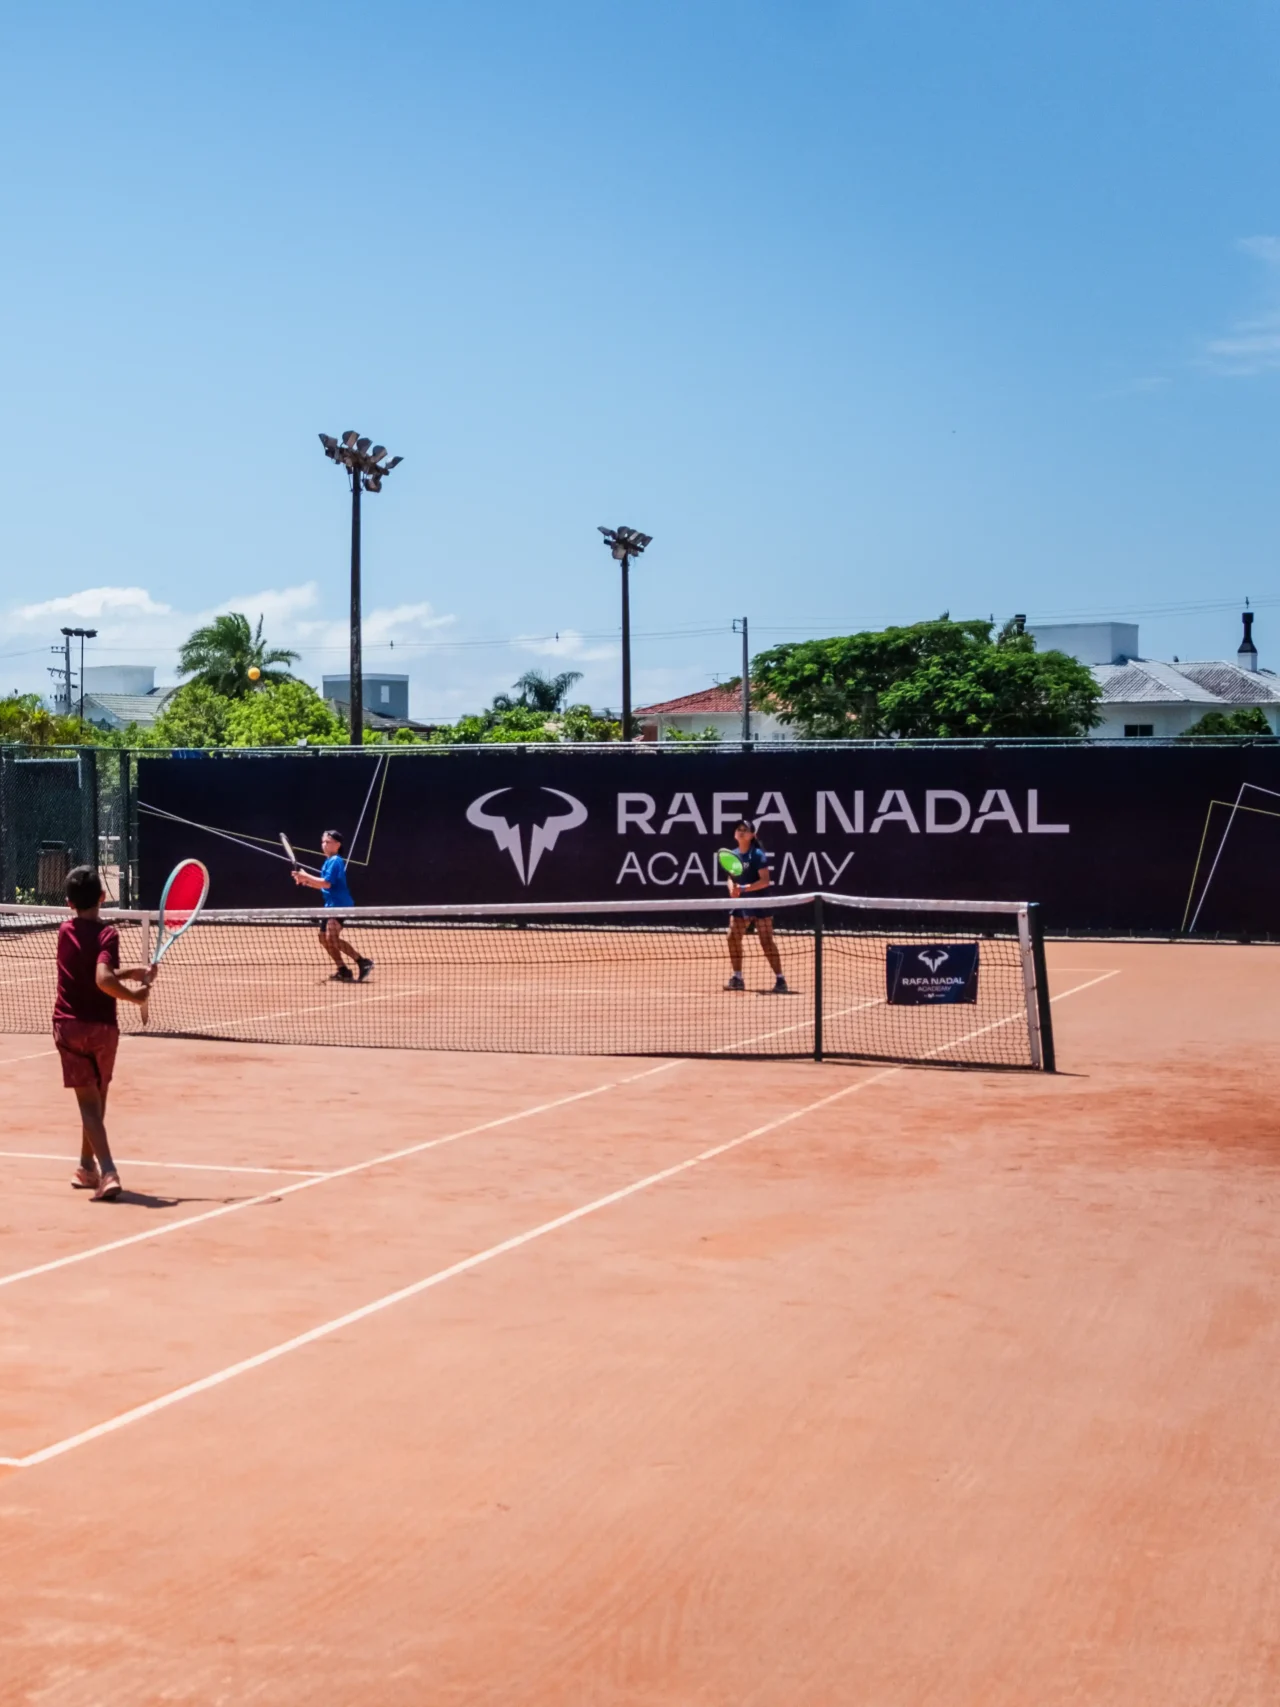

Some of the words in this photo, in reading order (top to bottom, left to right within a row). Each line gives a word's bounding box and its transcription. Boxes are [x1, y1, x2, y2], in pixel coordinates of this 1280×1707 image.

[617, 792, 797, 834] RAFA
[816, 789, 1070, 834] NADAL
[616, 851, 854, 886] ACAMY
[902, 978, 929, 986] RAFA
[931, 977, 965, 985] NADAL
